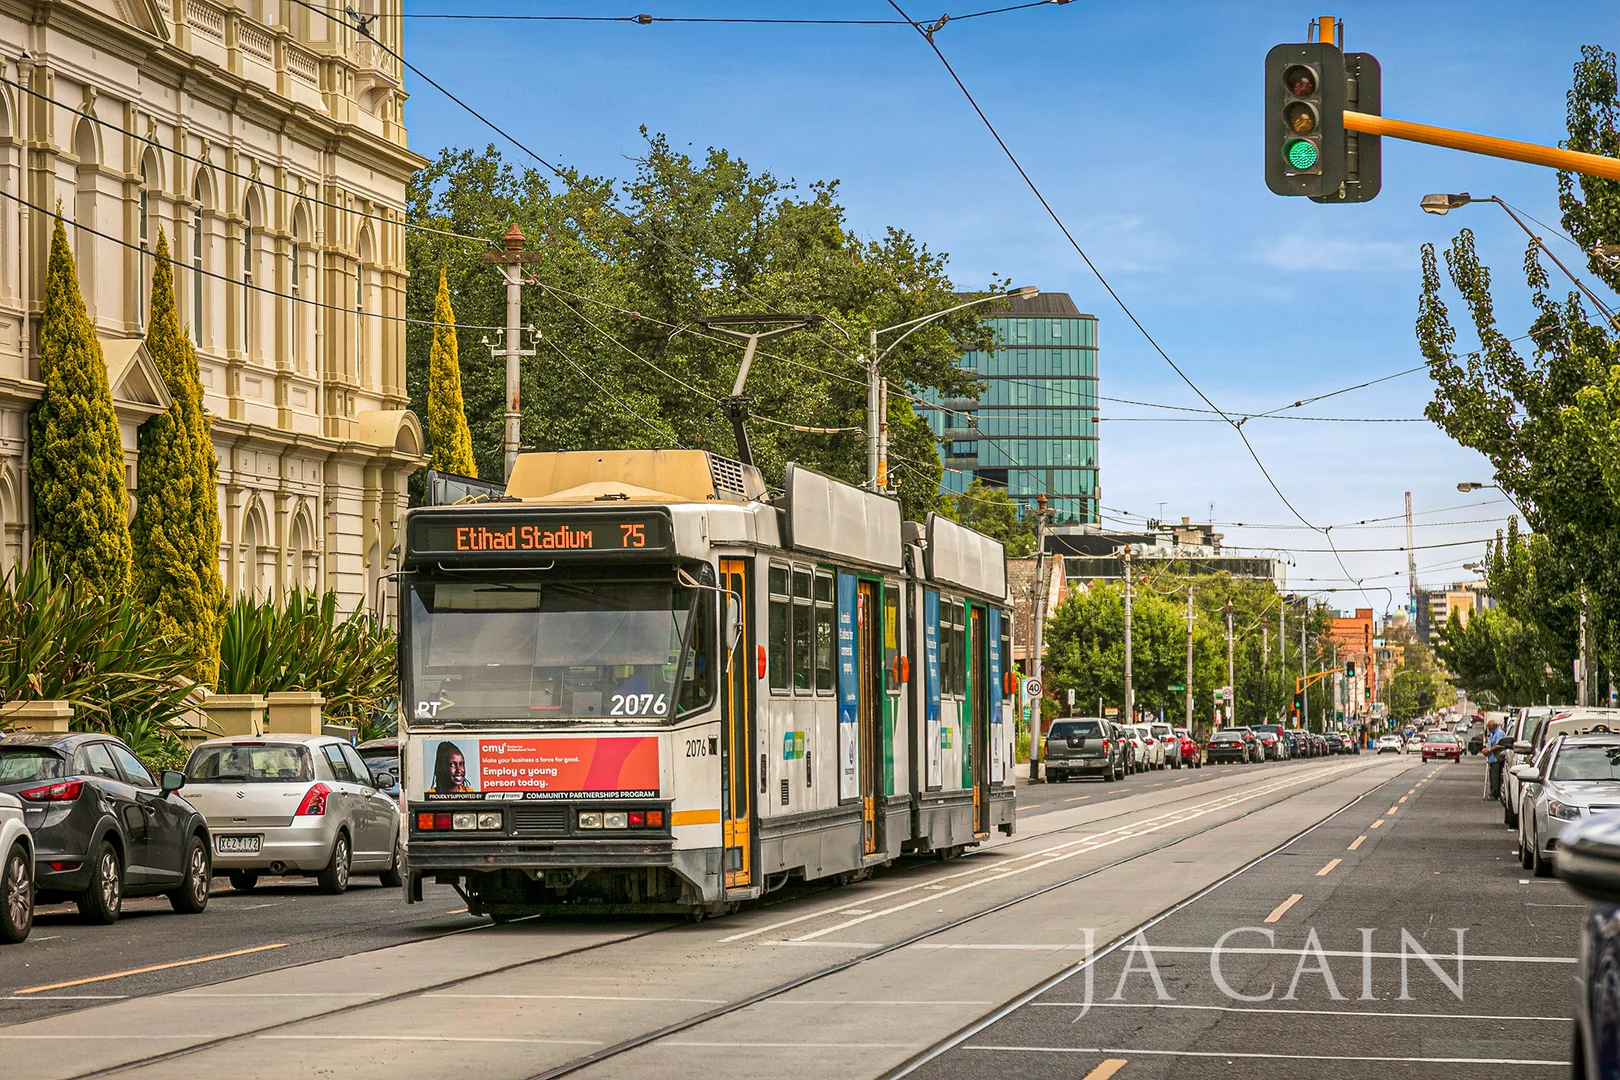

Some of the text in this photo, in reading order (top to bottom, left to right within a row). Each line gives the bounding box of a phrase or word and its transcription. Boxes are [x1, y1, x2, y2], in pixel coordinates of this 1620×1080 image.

[456, 524, 645, 550] Etihad Stadium 75
[1028, 683, 1040, 692] 40
[610, 694, 667, 715] 2076
[482, 744, 506, 755] cmy
[685, 739, 707, 757] 2076
[564, 756, 580, 764] good.
[483, 767, 517, 777] Employ
[528, 768, 558, 777] young
[483, 778, 548, 789] person today.
[221, 838, 258, 848] XCZ 172
